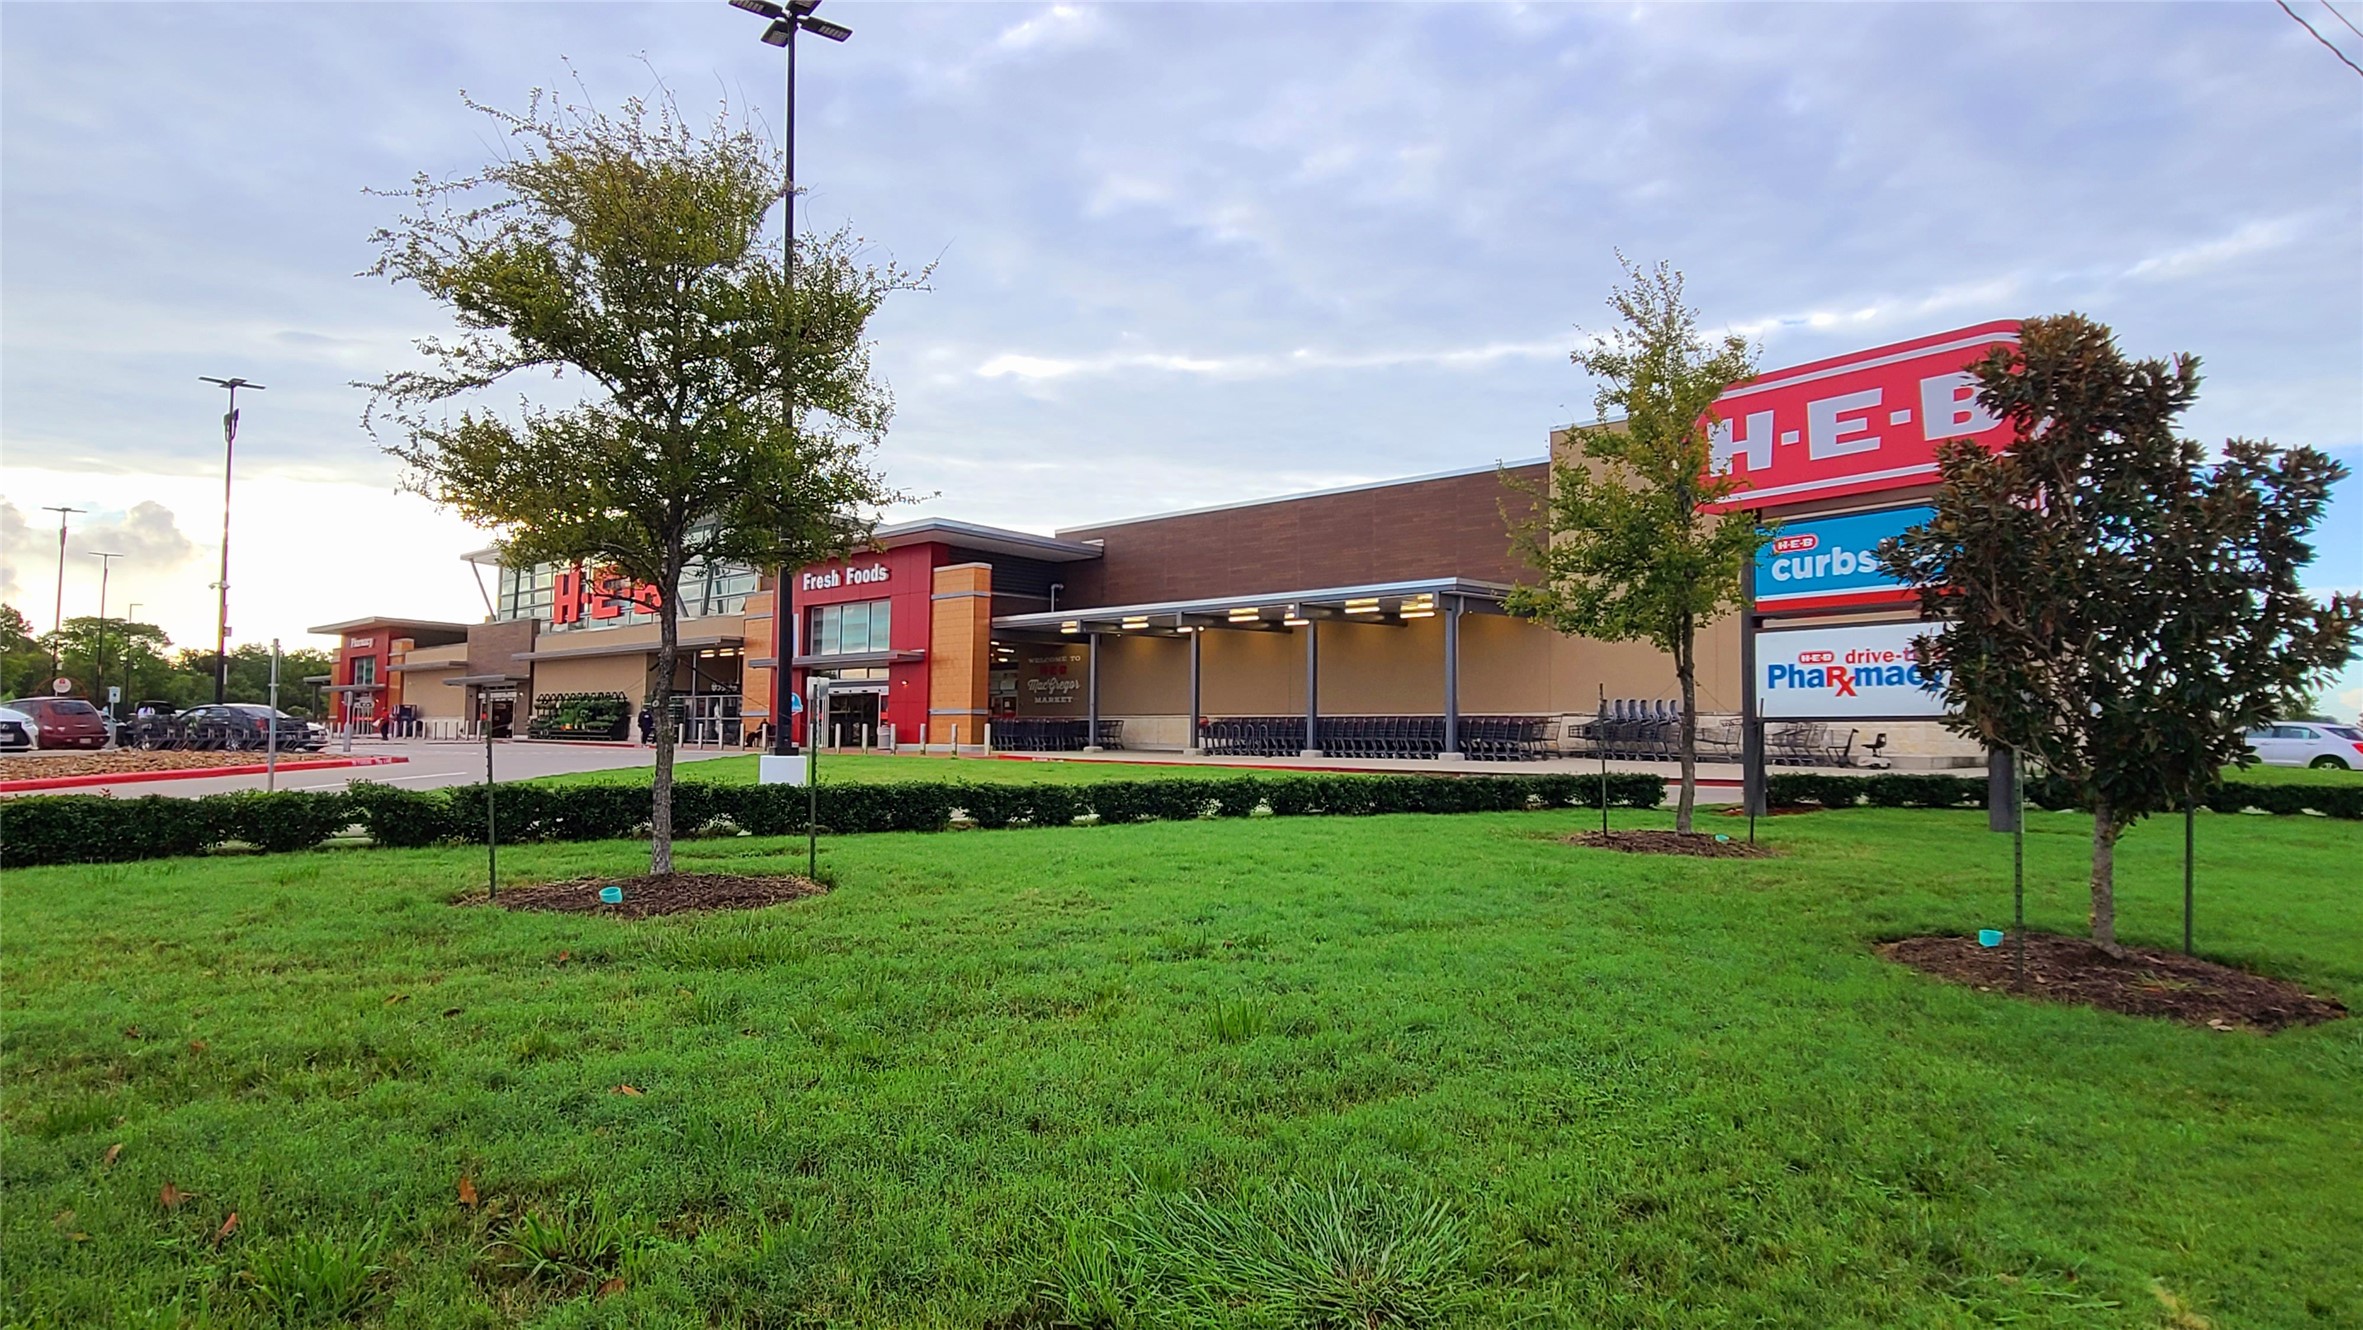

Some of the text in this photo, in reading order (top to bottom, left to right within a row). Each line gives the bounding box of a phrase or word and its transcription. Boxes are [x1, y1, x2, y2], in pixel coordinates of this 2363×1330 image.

[1706, 371, 2004, 477] H-E-B
[1777, 537, 1813, 550] H-E-B
[803, 563, 889, 591] Fresh Foods
[1771, 546, 1892, 582] curbs
[1801, 653, 1833, 662] H-E-B
